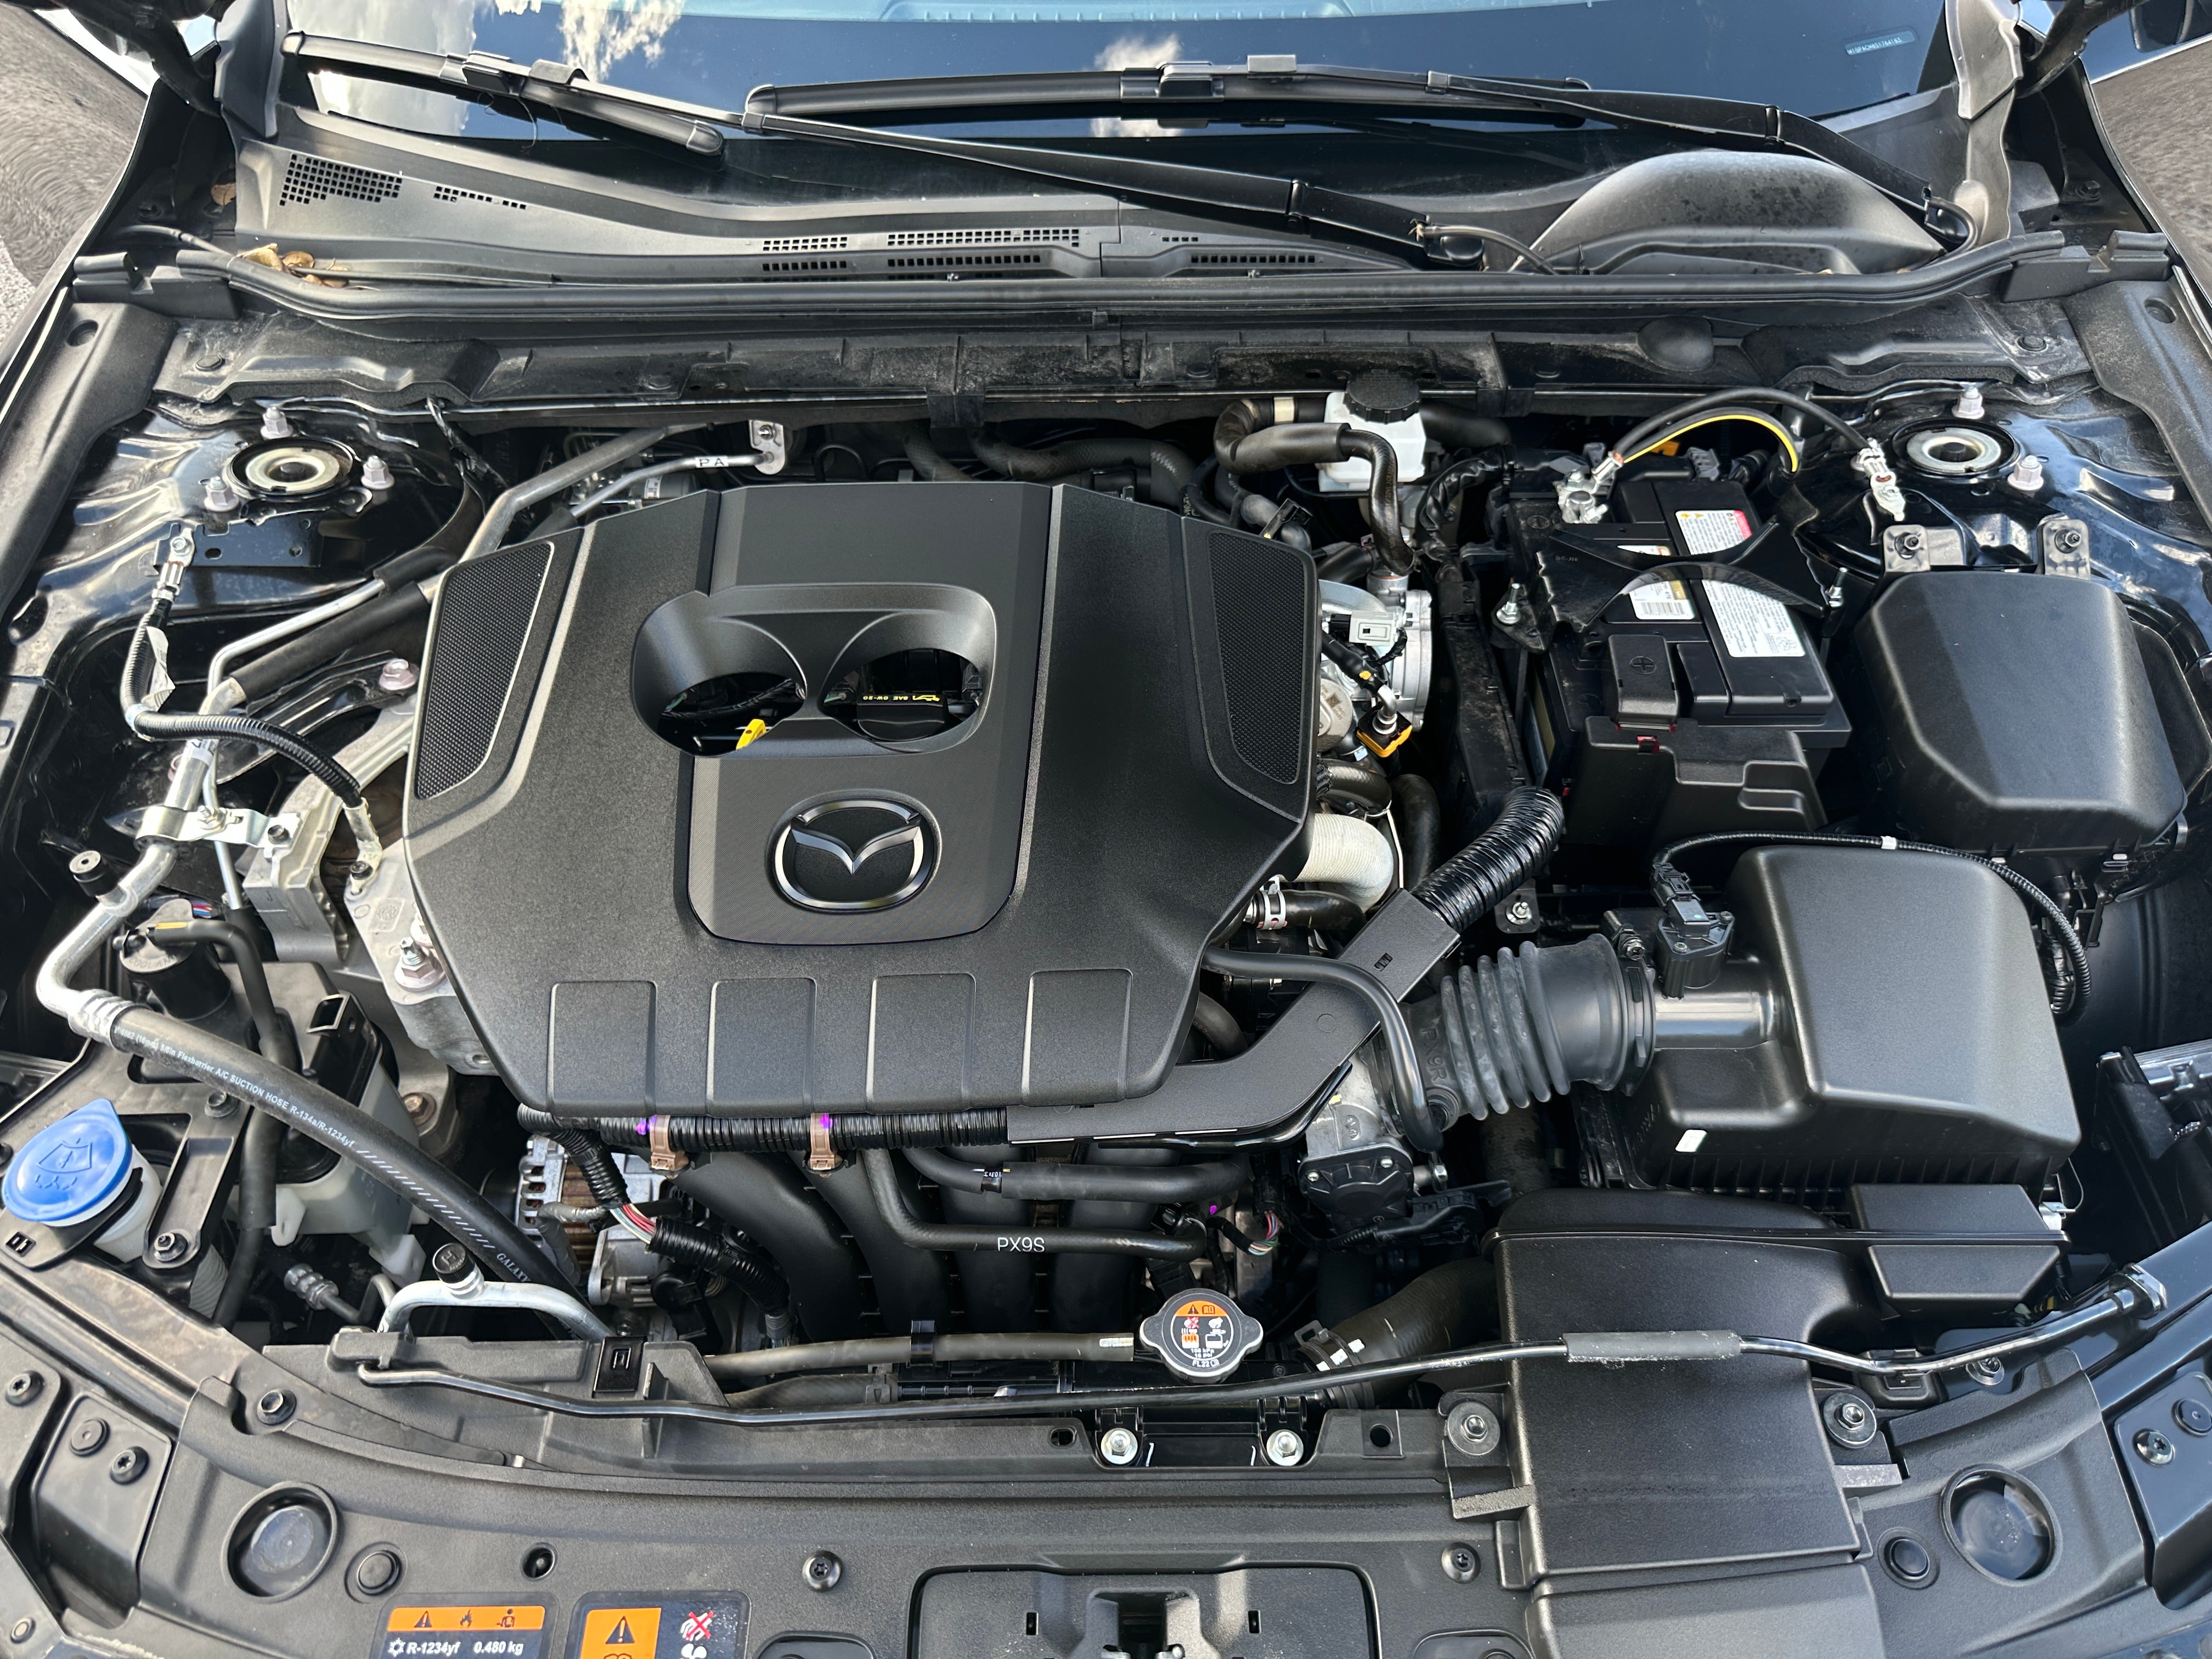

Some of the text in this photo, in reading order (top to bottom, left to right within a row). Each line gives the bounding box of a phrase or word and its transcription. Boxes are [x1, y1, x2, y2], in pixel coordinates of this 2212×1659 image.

[1420, 1026, 1447, 1081] PX9R
[177, 1051, 215, 1073] Flexbarrier
[216, 1068, 229, 1080] A/C
[230, 1075, 264, 1097] SUCTION
[266, 1092, 289, 1109] HOSE
[290, 1105, 355, 1148] R-134a/R-1234yf
[997, 1237, 1045, 1252] PX9S
[496, 1253, 532, 1283] GALAXY
[1192, 1359, 1210, 1368] FL22
[407, 1640, 524, 1657] R-1234yf 0.480 kg
